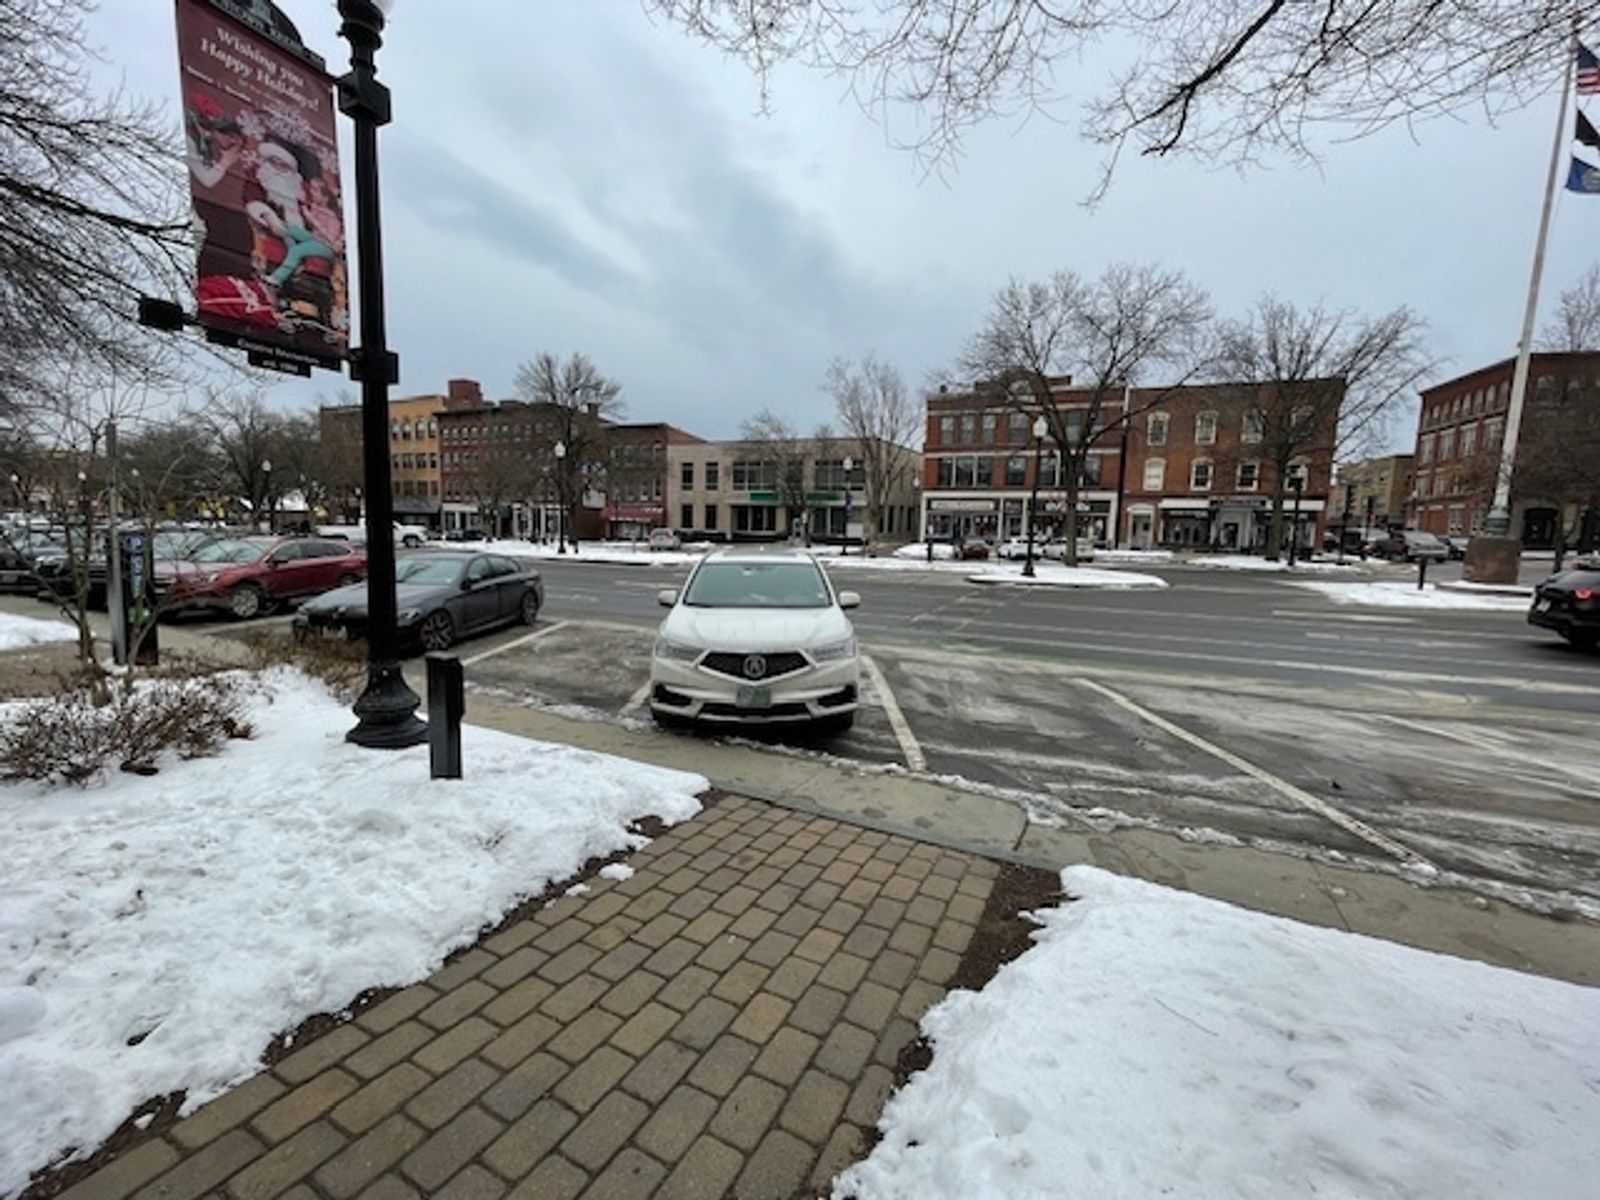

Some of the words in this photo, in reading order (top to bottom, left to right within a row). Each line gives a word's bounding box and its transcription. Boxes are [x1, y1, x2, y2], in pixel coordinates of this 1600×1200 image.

[202, 38, 252, 77] Happy
[257, 71, 319, 112] Holidays!
[217, 27, 277, 75] Wishing
[281, 67, 303, 87] you
